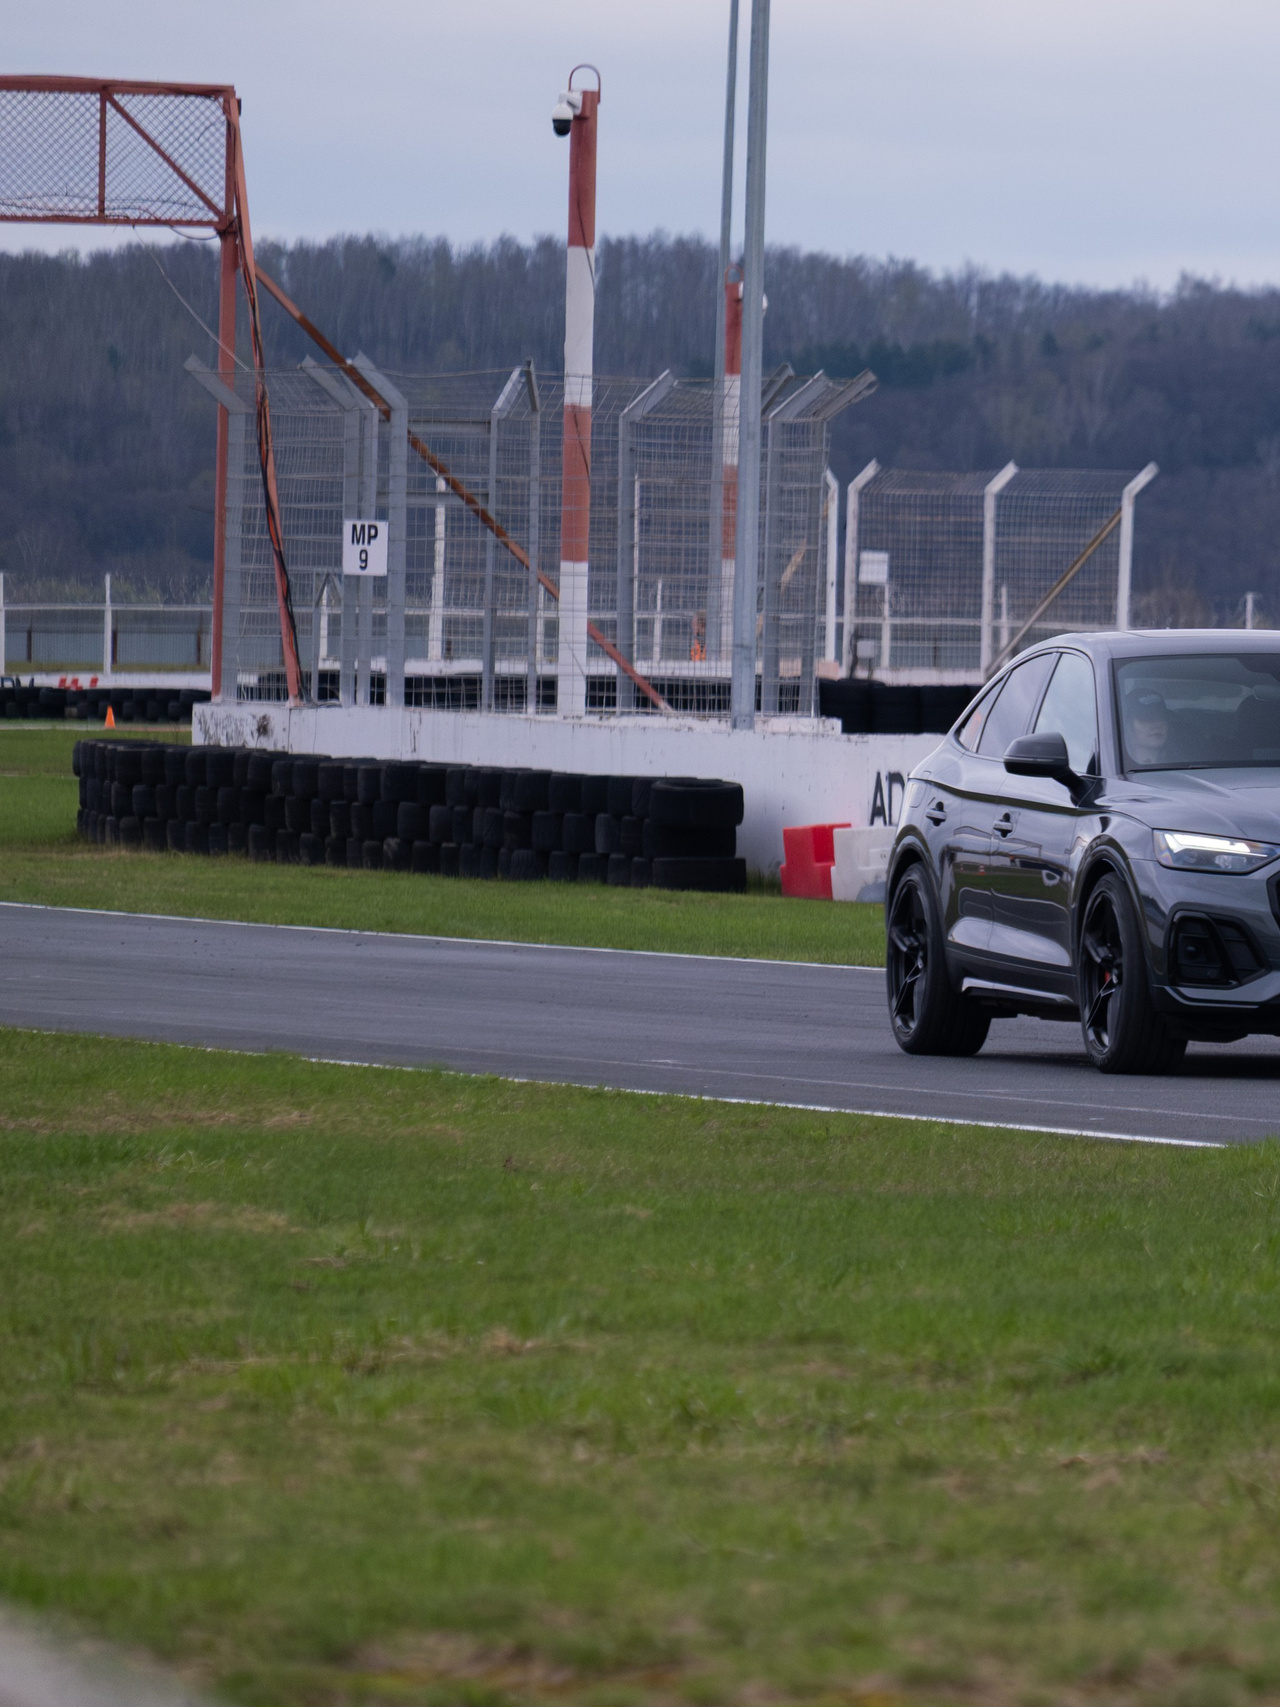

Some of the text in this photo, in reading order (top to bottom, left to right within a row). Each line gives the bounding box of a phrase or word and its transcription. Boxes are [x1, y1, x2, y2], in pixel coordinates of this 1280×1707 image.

[352, 524, 378, 545] MP
[359, 549, 368, 570] 9
[869, 771, 911, 826] AD
